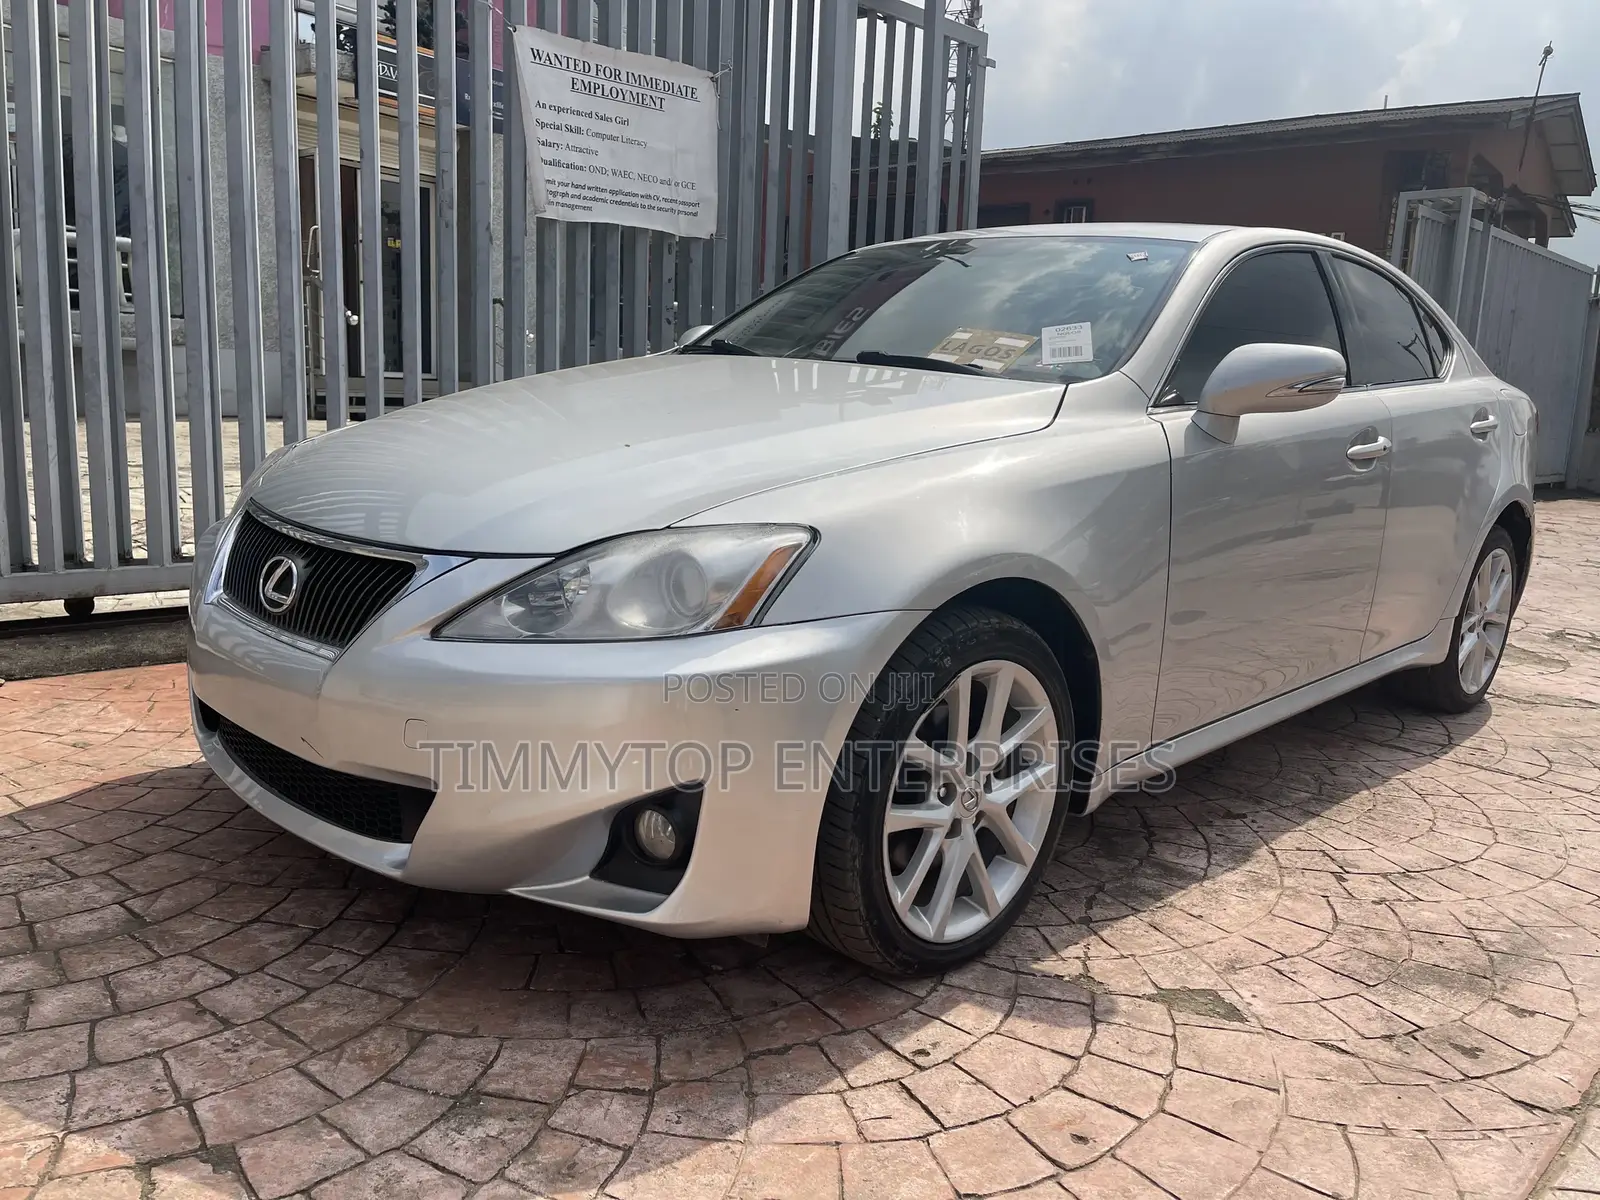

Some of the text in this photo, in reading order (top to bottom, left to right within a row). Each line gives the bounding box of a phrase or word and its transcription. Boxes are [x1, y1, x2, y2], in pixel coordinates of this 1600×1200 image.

[530, 47, 698, 100] WANTED FOR IMMEDIATE
[570, 76, 666, 110] EMPLOYMENT
[535, 100, 630, 126] An experienced Sales Girl
[535, 118, 648, 149] Special Skill: Computer Literacy
[565, 143, 599, 156] Attractive
[557, 180, 570, 188] your
[571, 181, 586, 191] hand
[587, 184, 608, 194] written
[608, 188, 639, 198] application
[662, 196, 678, 205] recent
[637, 172, 659, 184] NECO
[681, 180, 697, 191] GCE
[555, 201, 593, 212] management
[570, 192, 582, 200] and
[582, 195, 609, 204] academic
[609, 198, 640, 209] credentials
[640, 202, 647, 210] to
[647, 203, 656, 211] the
[656, 205, 677, 215] security
[939, 340, 1017, 360] LAGOS
